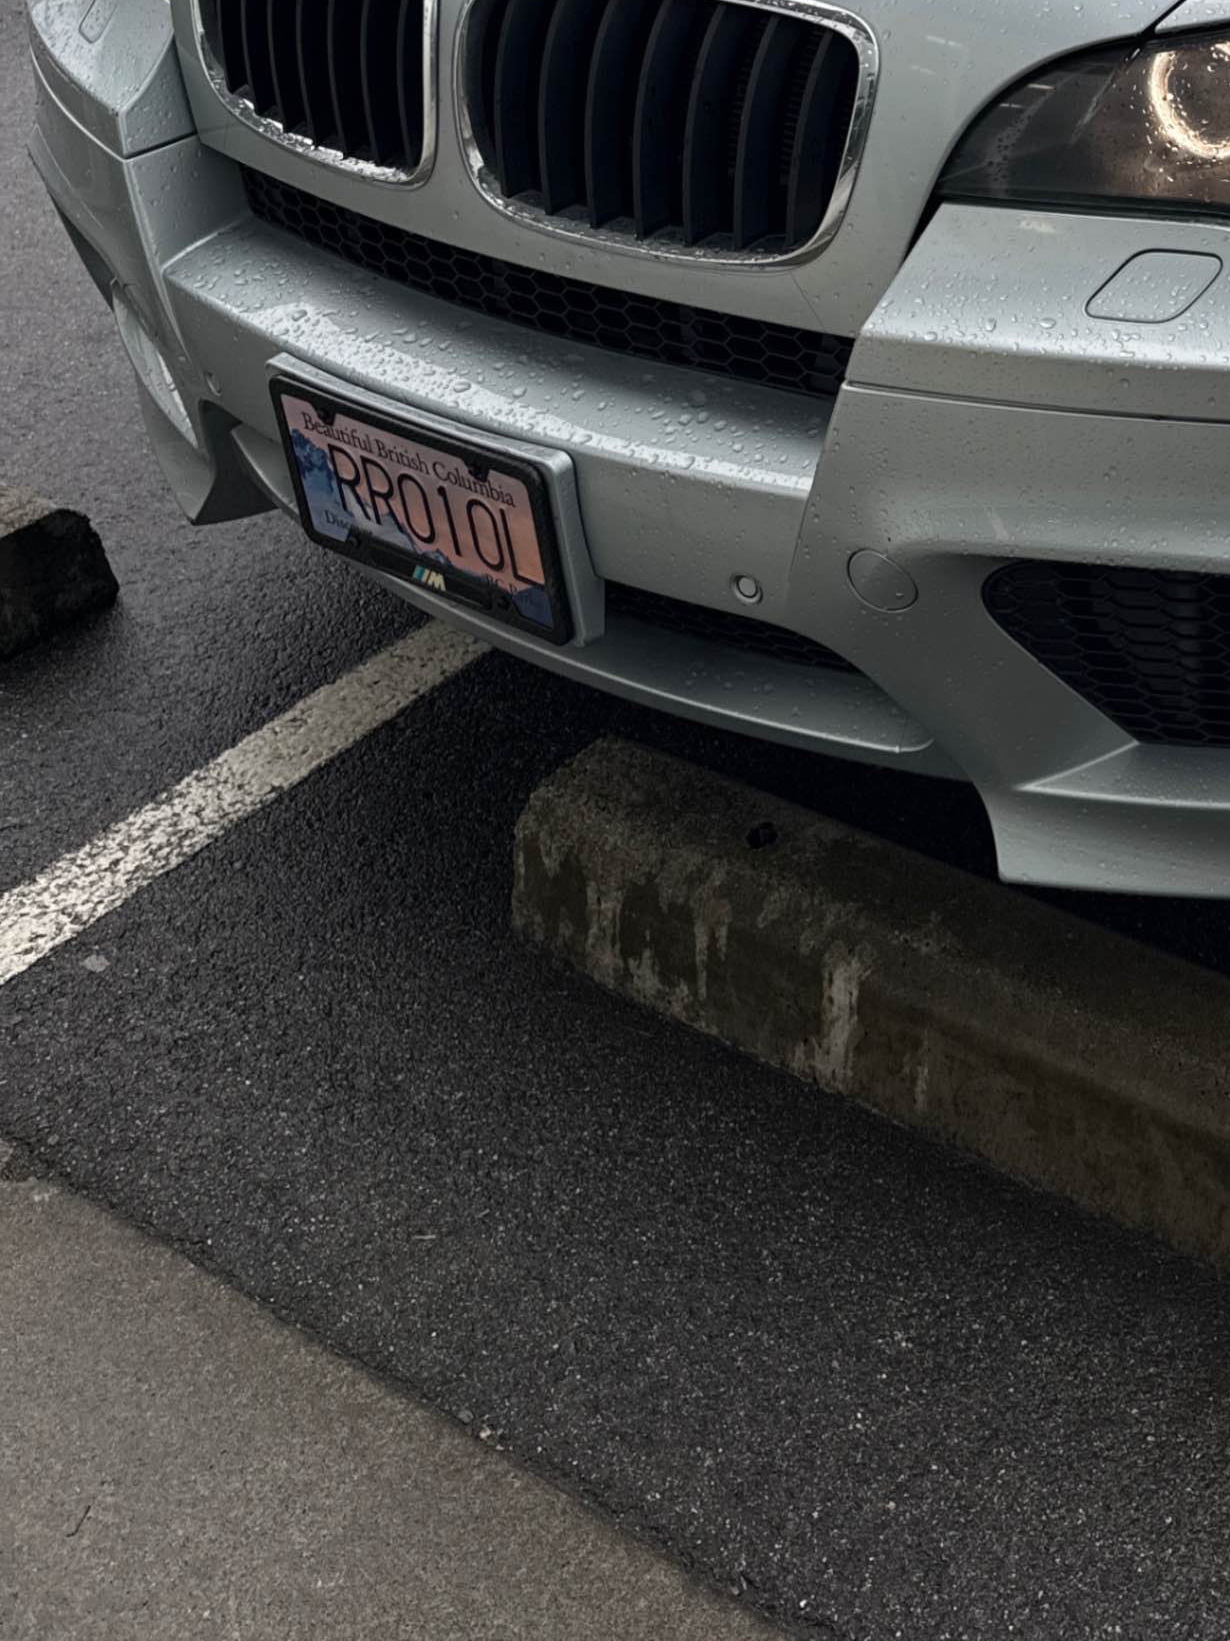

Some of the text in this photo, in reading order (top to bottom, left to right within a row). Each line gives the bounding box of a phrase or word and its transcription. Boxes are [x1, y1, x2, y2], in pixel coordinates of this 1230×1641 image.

[302, 412, 516, 508] Beautiful British Columbia
